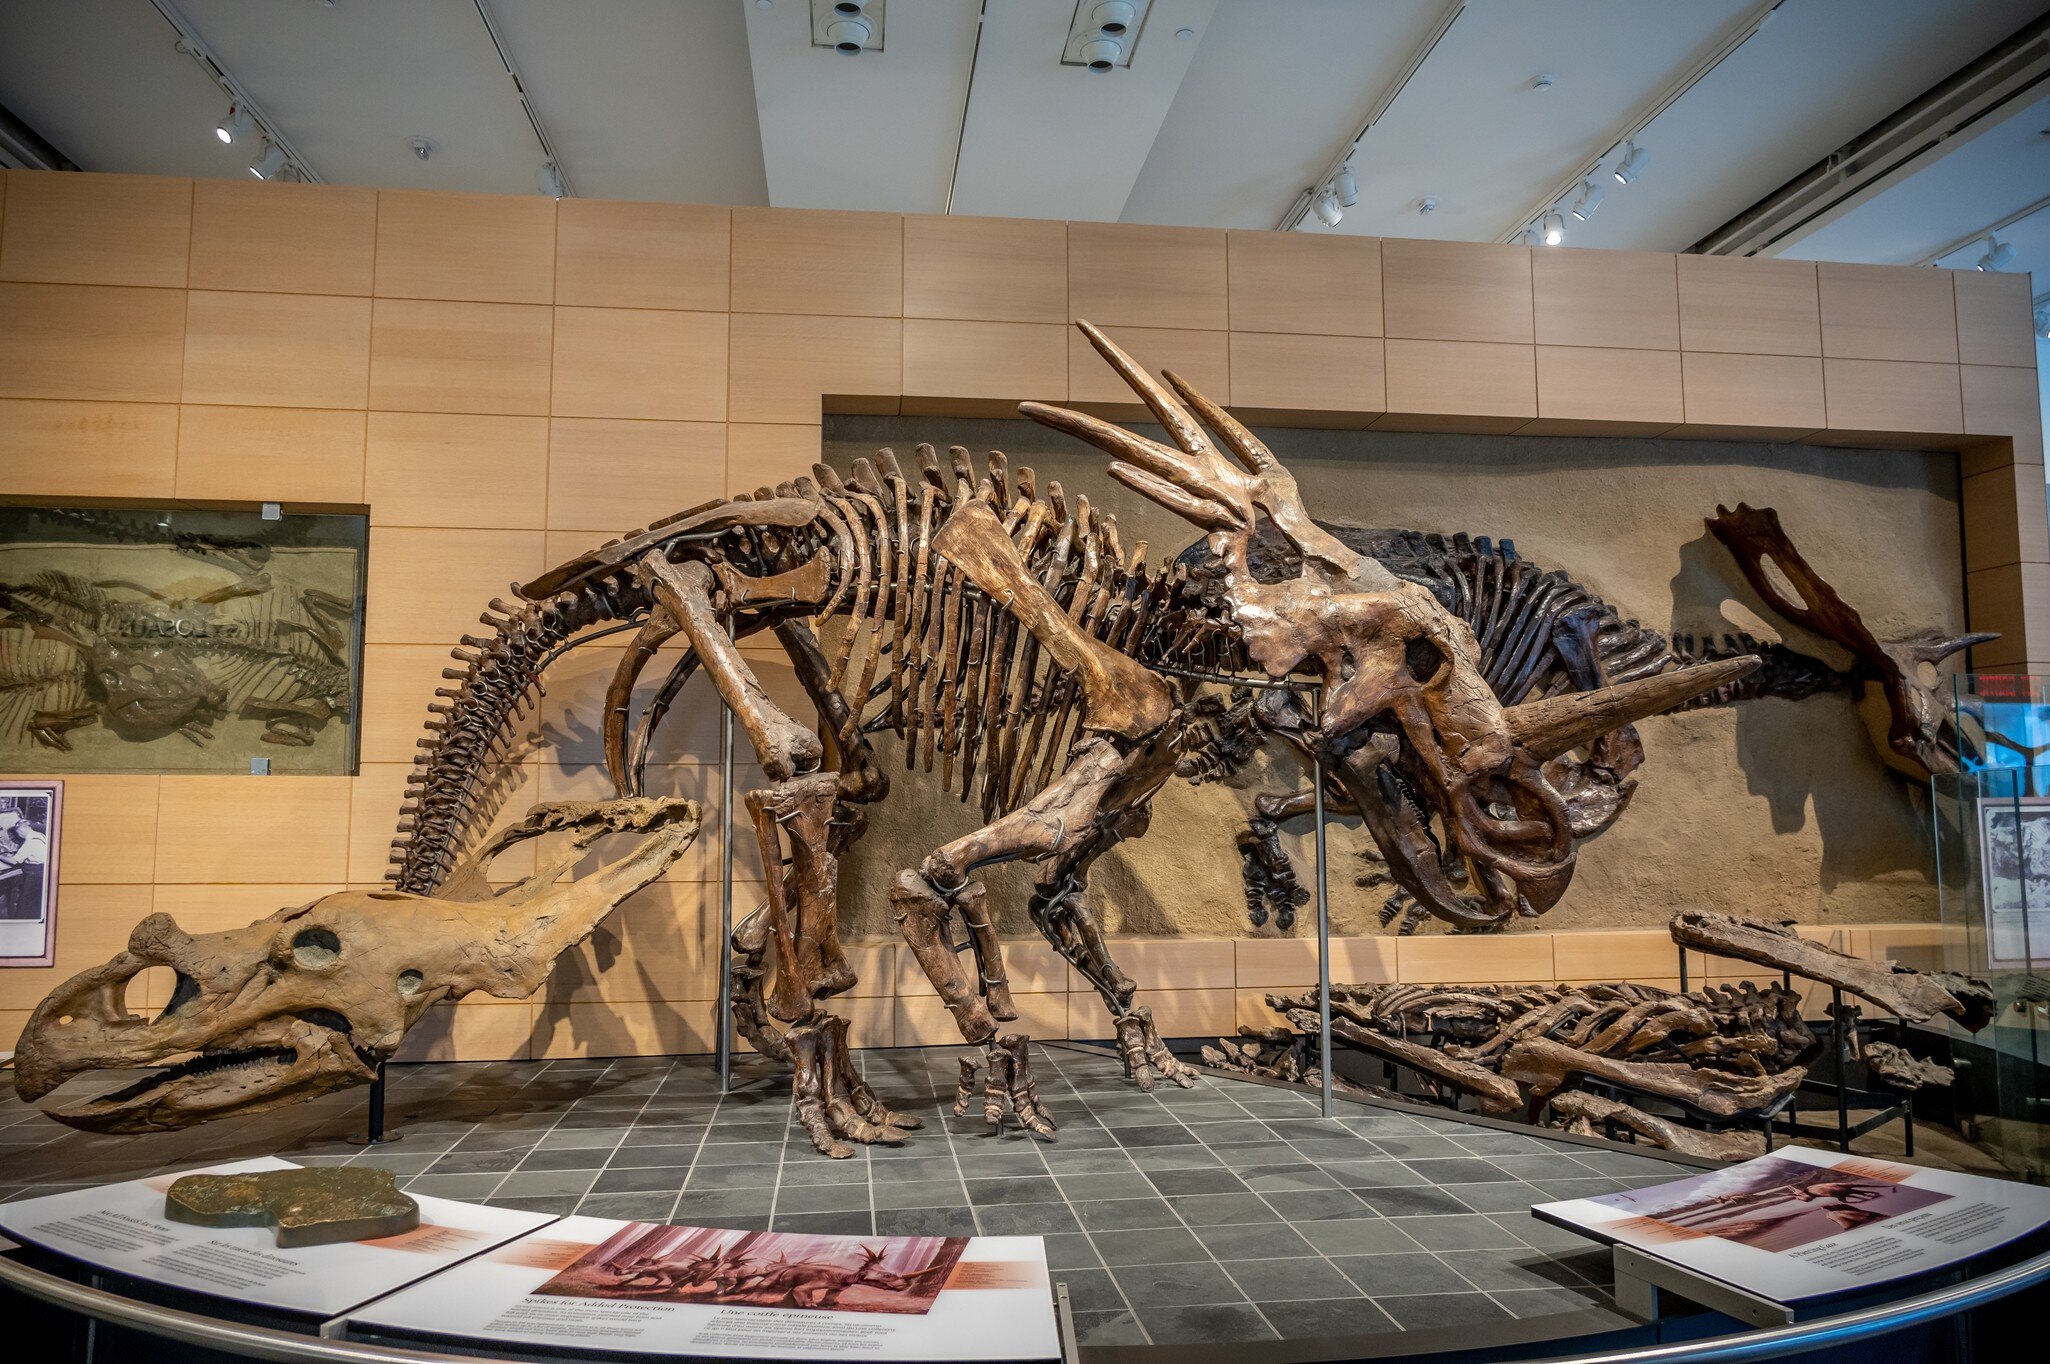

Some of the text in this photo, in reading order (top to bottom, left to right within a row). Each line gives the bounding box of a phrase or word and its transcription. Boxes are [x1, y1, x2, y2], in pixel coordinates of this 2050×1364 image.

[521, 1297, 559, 1306] Spikes
[577, 1300, 616, 1309] Added
[618, 1302, 676, 1312] Protection
